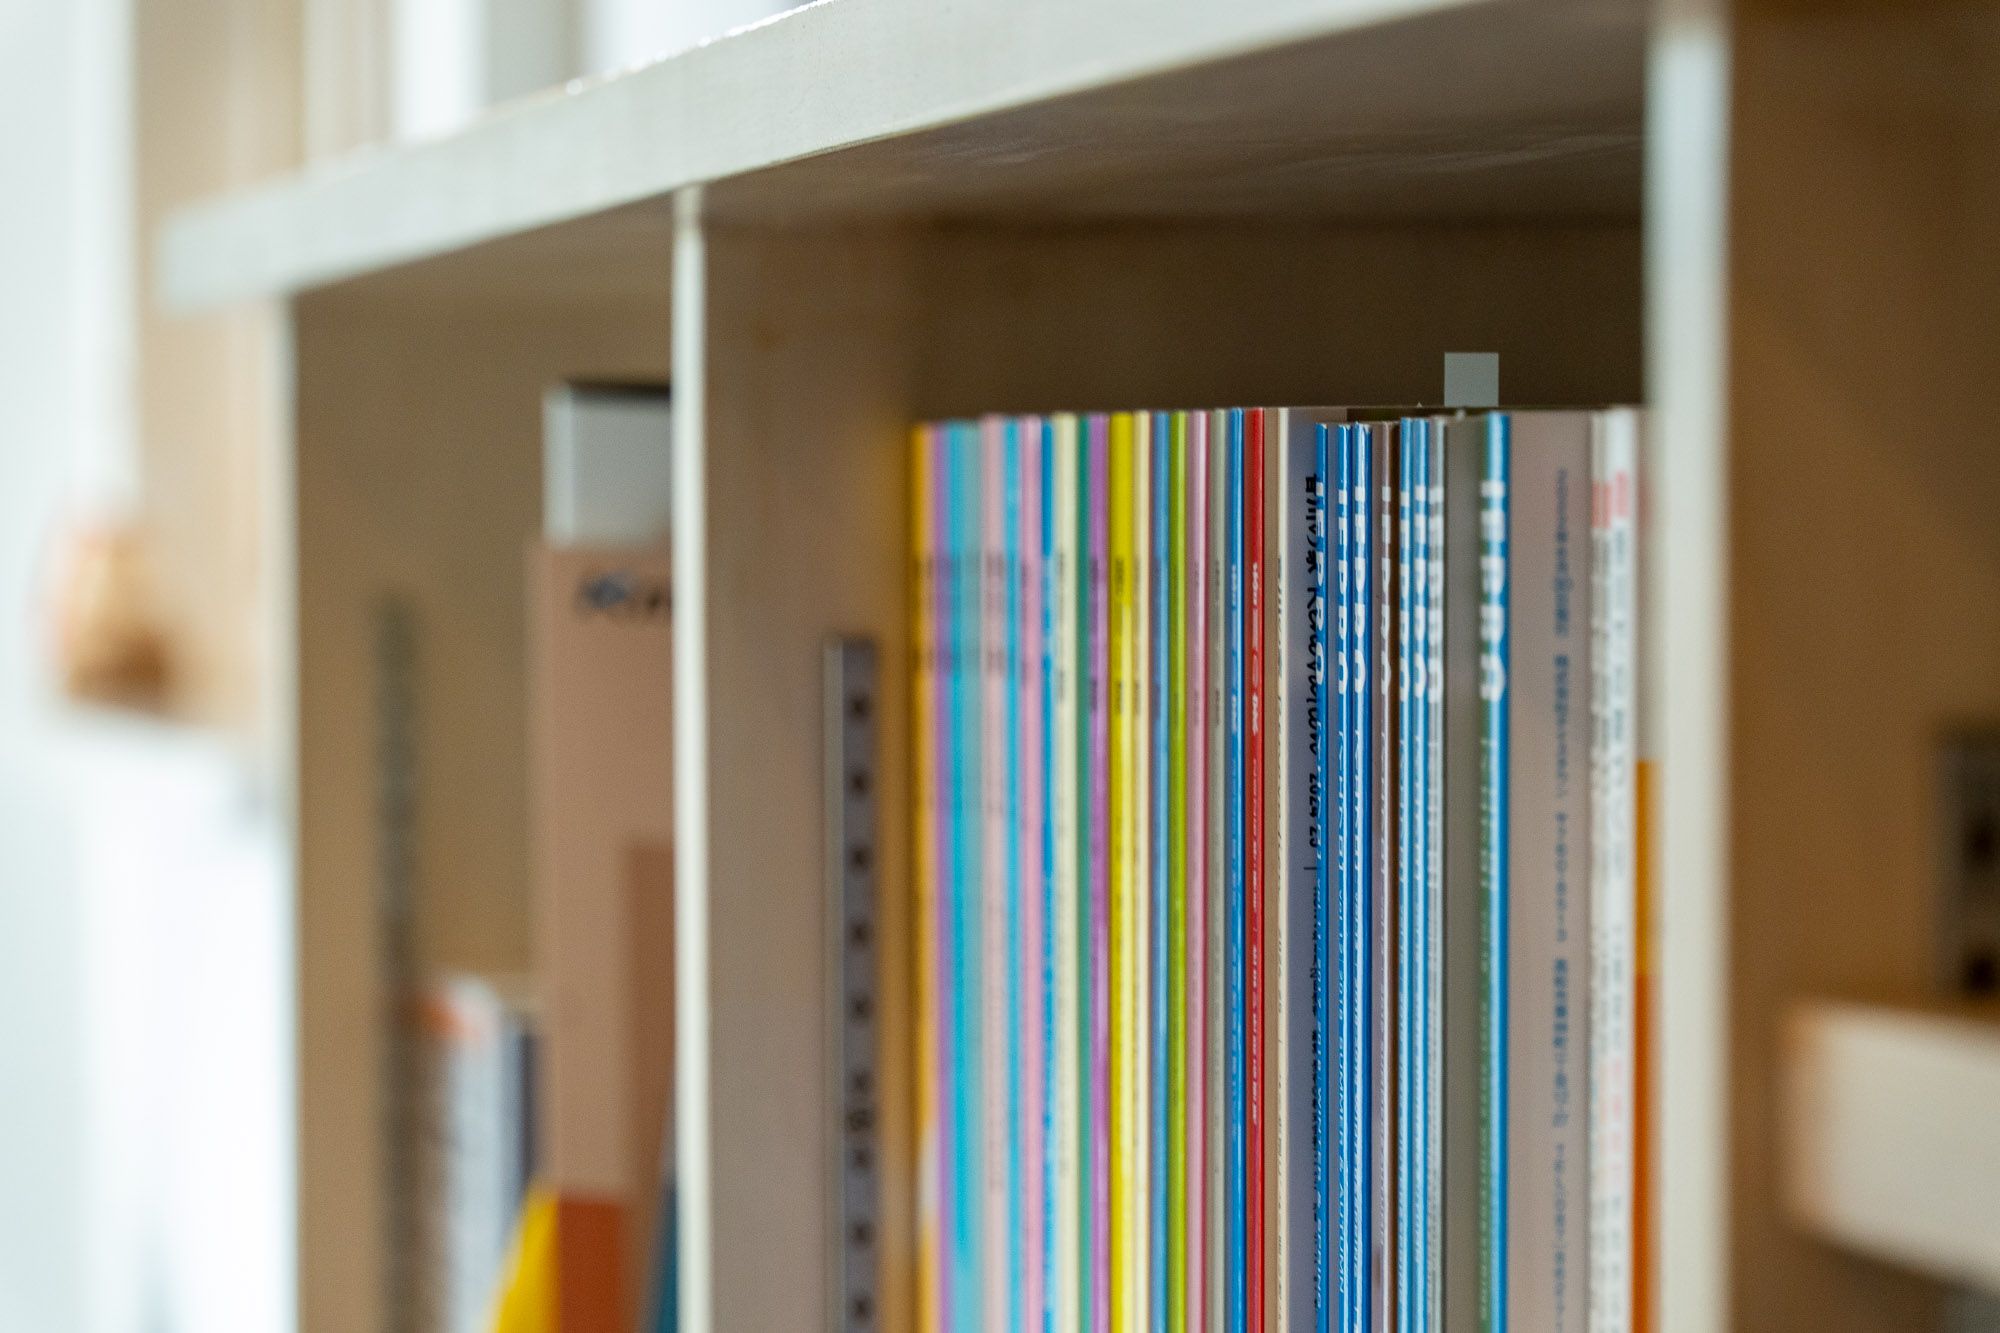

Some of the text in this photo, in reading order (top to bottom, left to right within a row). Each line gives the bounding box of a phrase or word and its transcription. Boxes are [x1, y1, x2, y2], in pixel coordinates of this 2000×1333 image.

[1315, 481, 1325, 685] IEPRO
[1338, 489, 1348, 695] IEPRO
[1354, 486, 1365, 694] IEPRO
